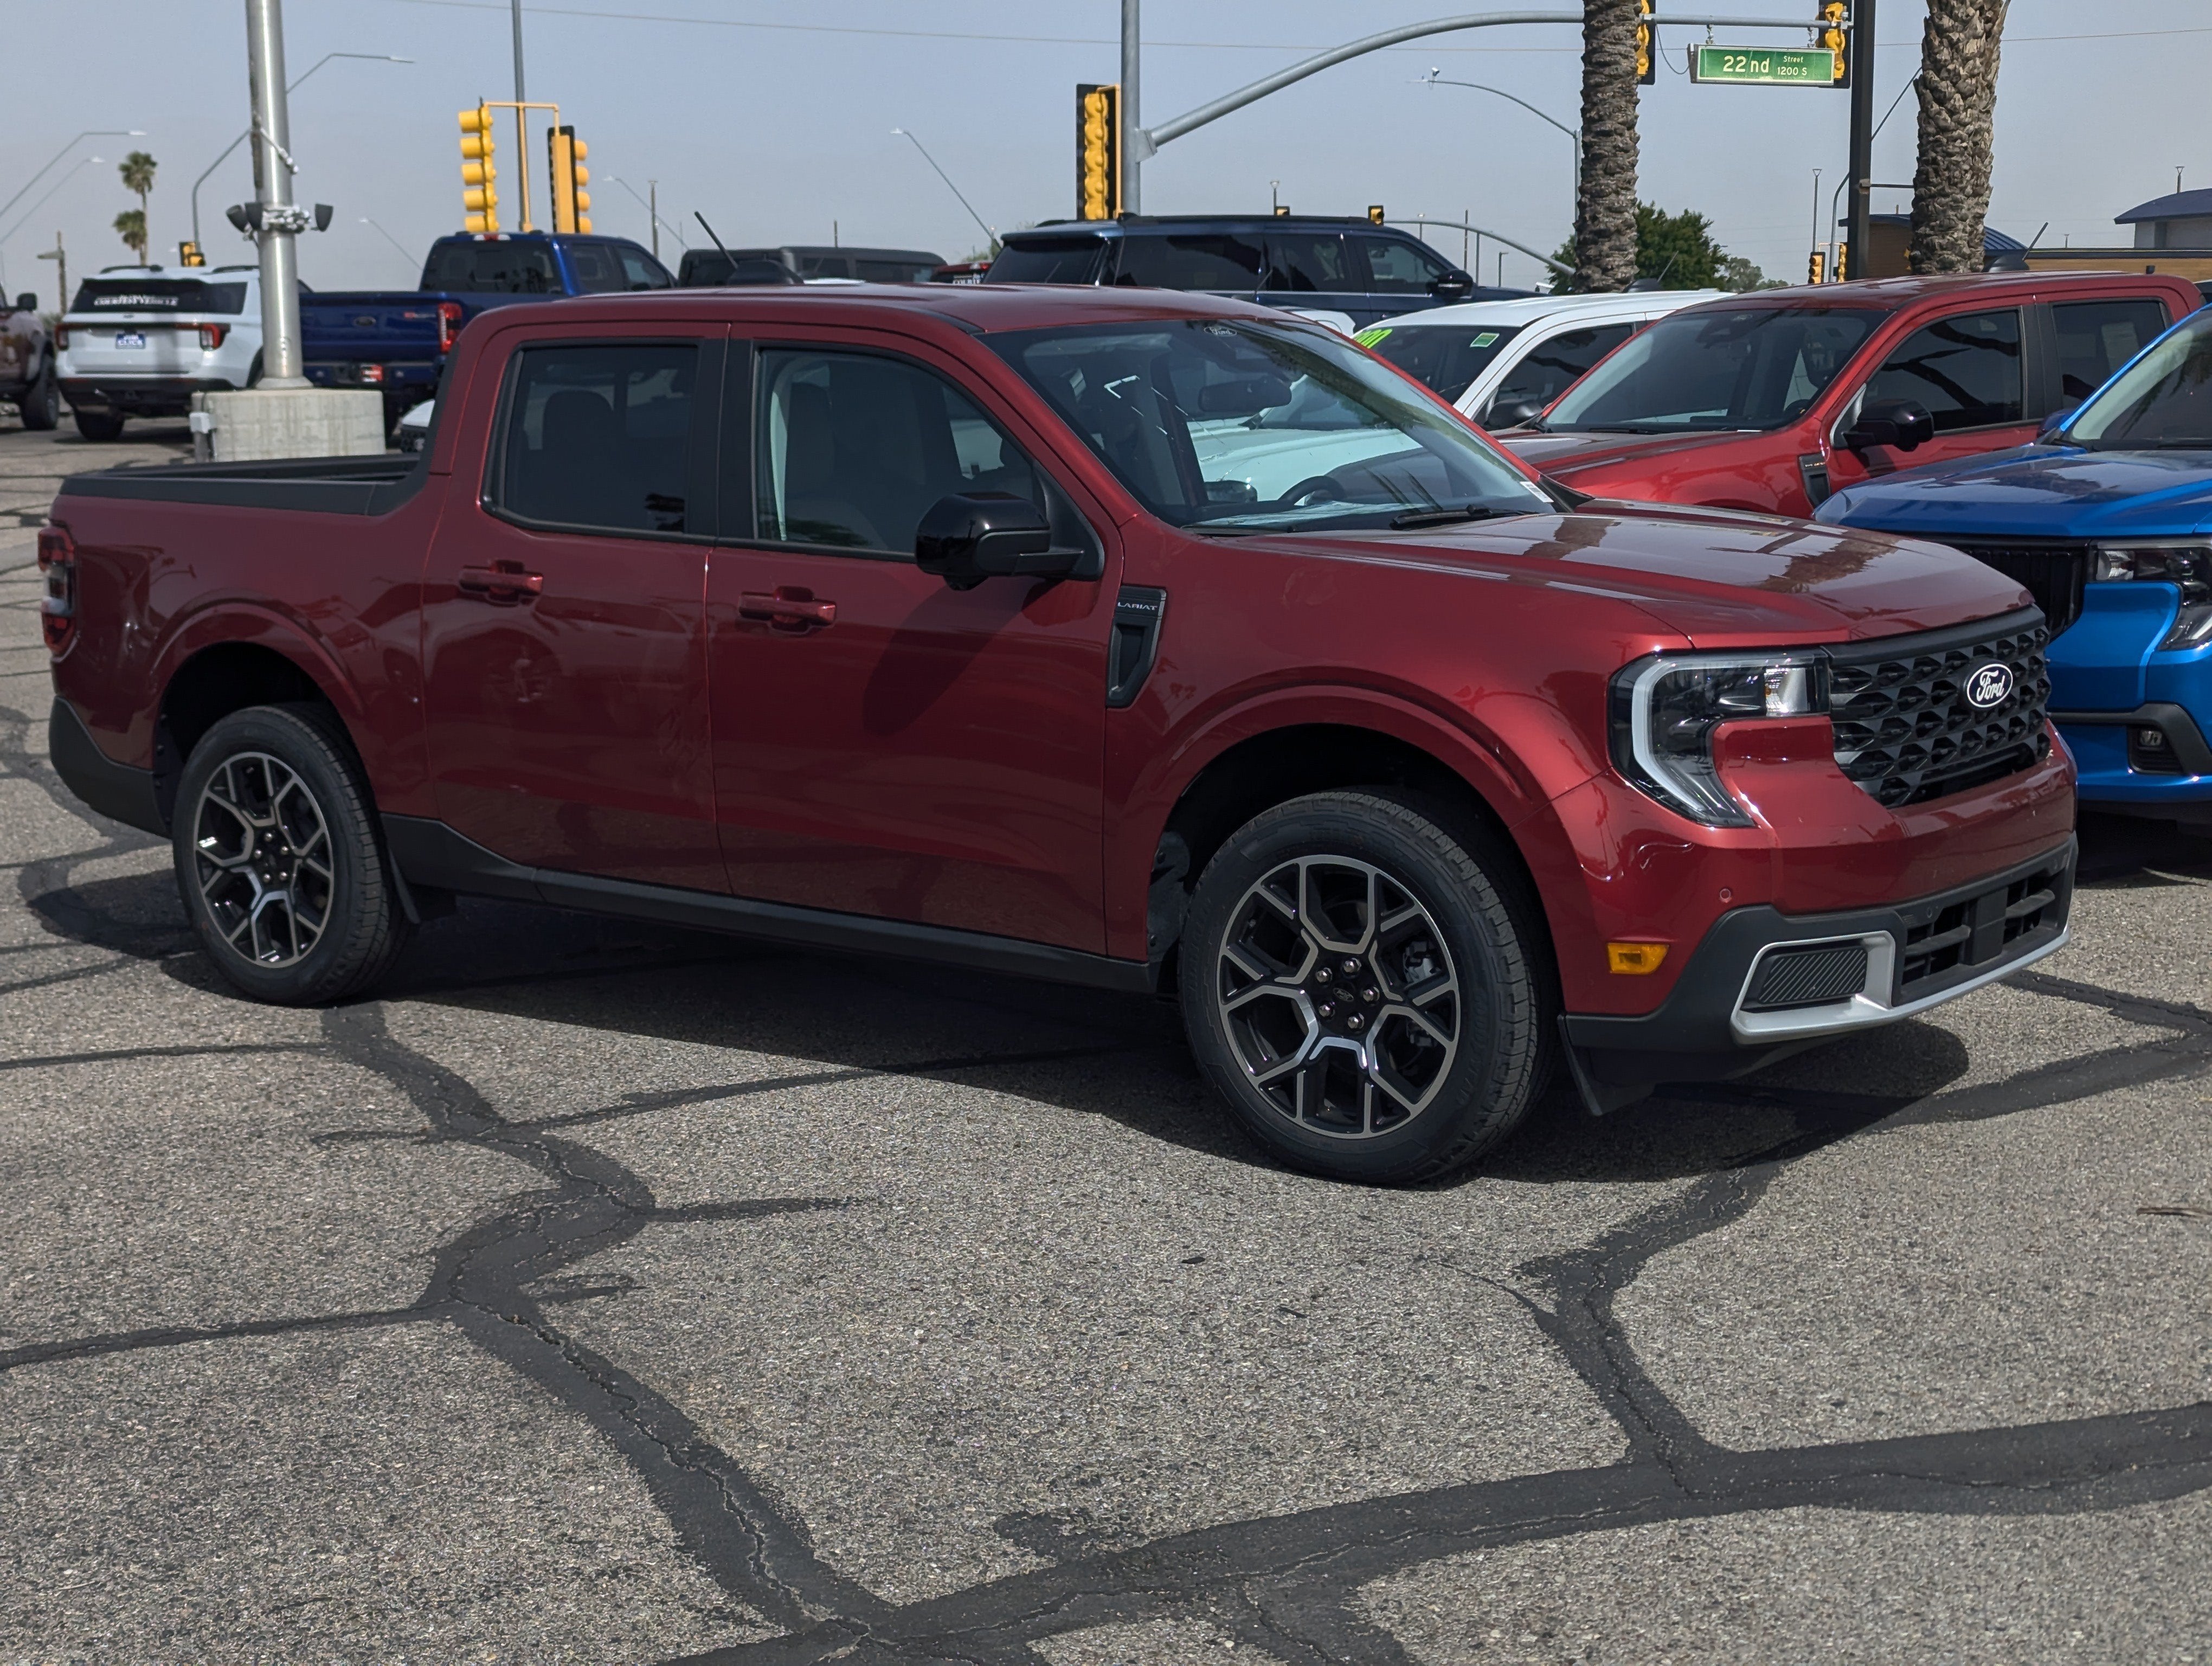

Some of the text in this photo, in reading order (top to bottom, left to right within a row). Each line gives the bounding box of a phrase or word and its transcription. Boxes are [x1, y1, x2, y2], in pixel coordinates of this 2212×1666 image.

[1723, 55, 1770, 73] 22nd
[1777, 67, 1807, 75] 1200 S
[1117, 602, 1158, 611] LARIAT
[1976, 670, 2005, 702] Ford
